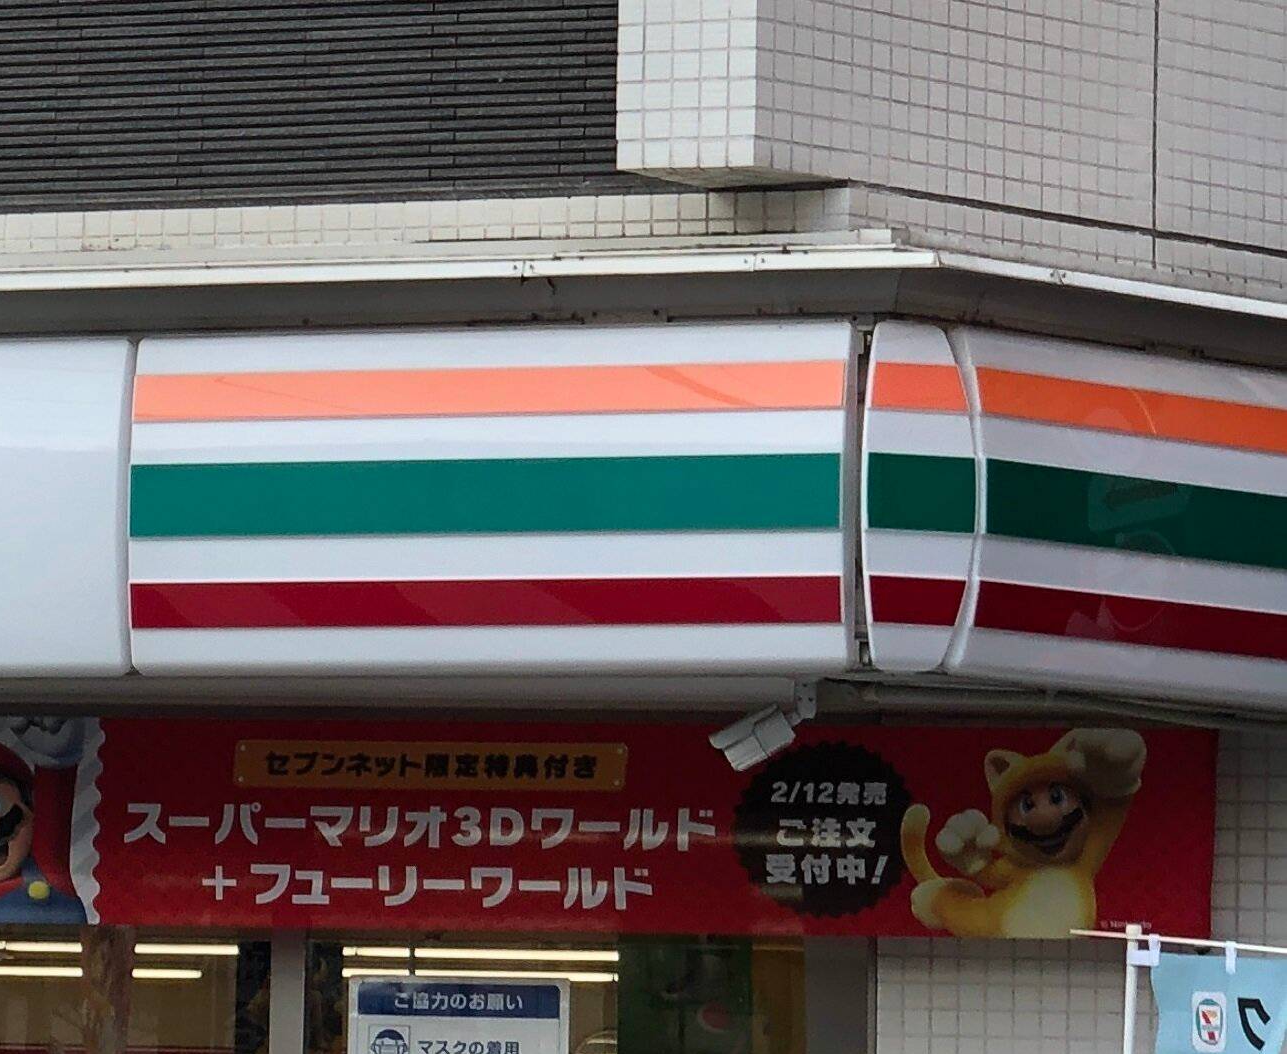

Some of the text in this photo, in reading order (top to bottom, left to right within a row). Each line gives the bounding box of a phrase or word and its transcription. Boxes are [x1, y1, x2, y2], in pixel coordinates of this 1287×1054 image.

[265, 751, 599, 782] セブンネット限定特典付き
[769, 780, 889, 807] 2/12発売
[123, 801, 715, 851] スーパーマリオ3Dワールド
[775, 818, 878, 850] ご注文
[765, 853, 891, 887] 受付中!
[394, 991, 524, 1011] ご協力のお願い
